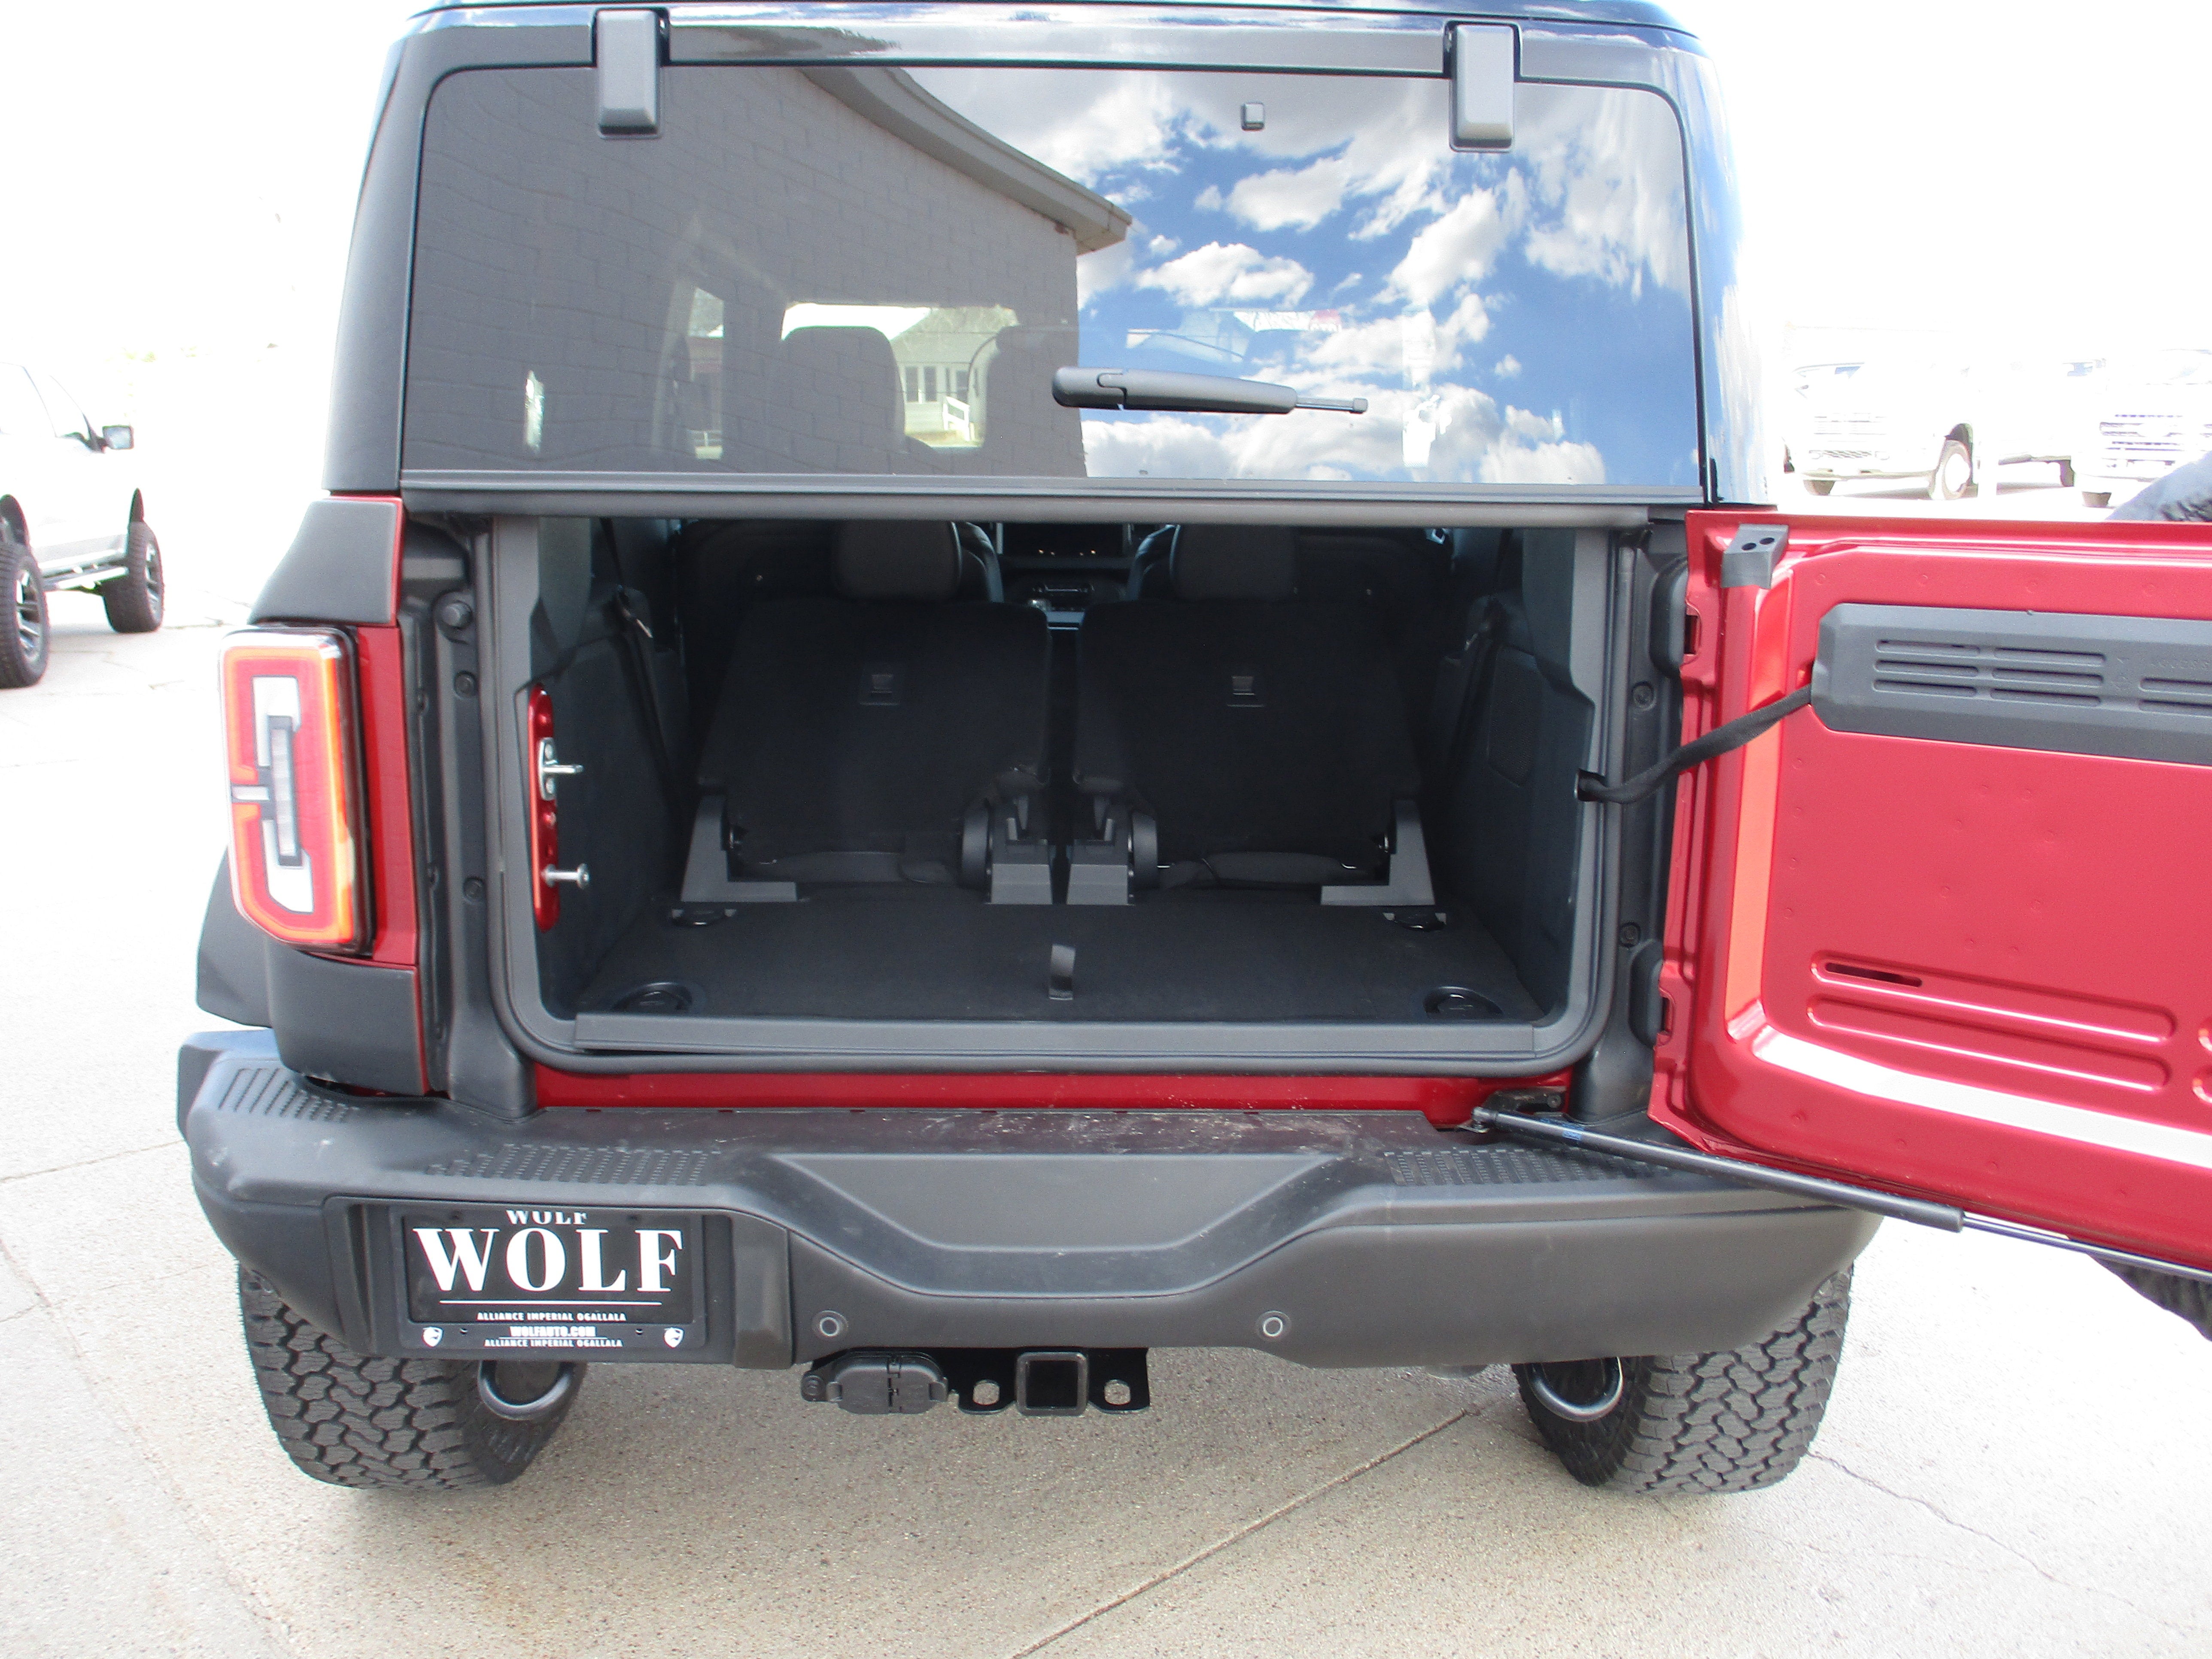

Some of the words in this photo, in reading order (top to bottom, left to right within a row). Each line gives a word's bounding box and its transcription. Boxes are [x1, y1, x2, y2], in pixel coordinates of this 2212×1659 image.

[506, 1210, 587, 1224] WOLF
[413, 1227, 683, 1292] WOLF
[476, 1312, 525, 1321] ALLIANCE
[526, 1312, 574, 1321] IMPERIAL
[576, 1313, 627, 1322] OGALLALA
[509, 1325, 596, 1337] WOLFAUTO.COM
[484, 1339, 529, 1347] ALLIANCE
[530, 1339, 574, 1347] IMPERIAL
[576, 1339, 623, 1348] OGALLALA
